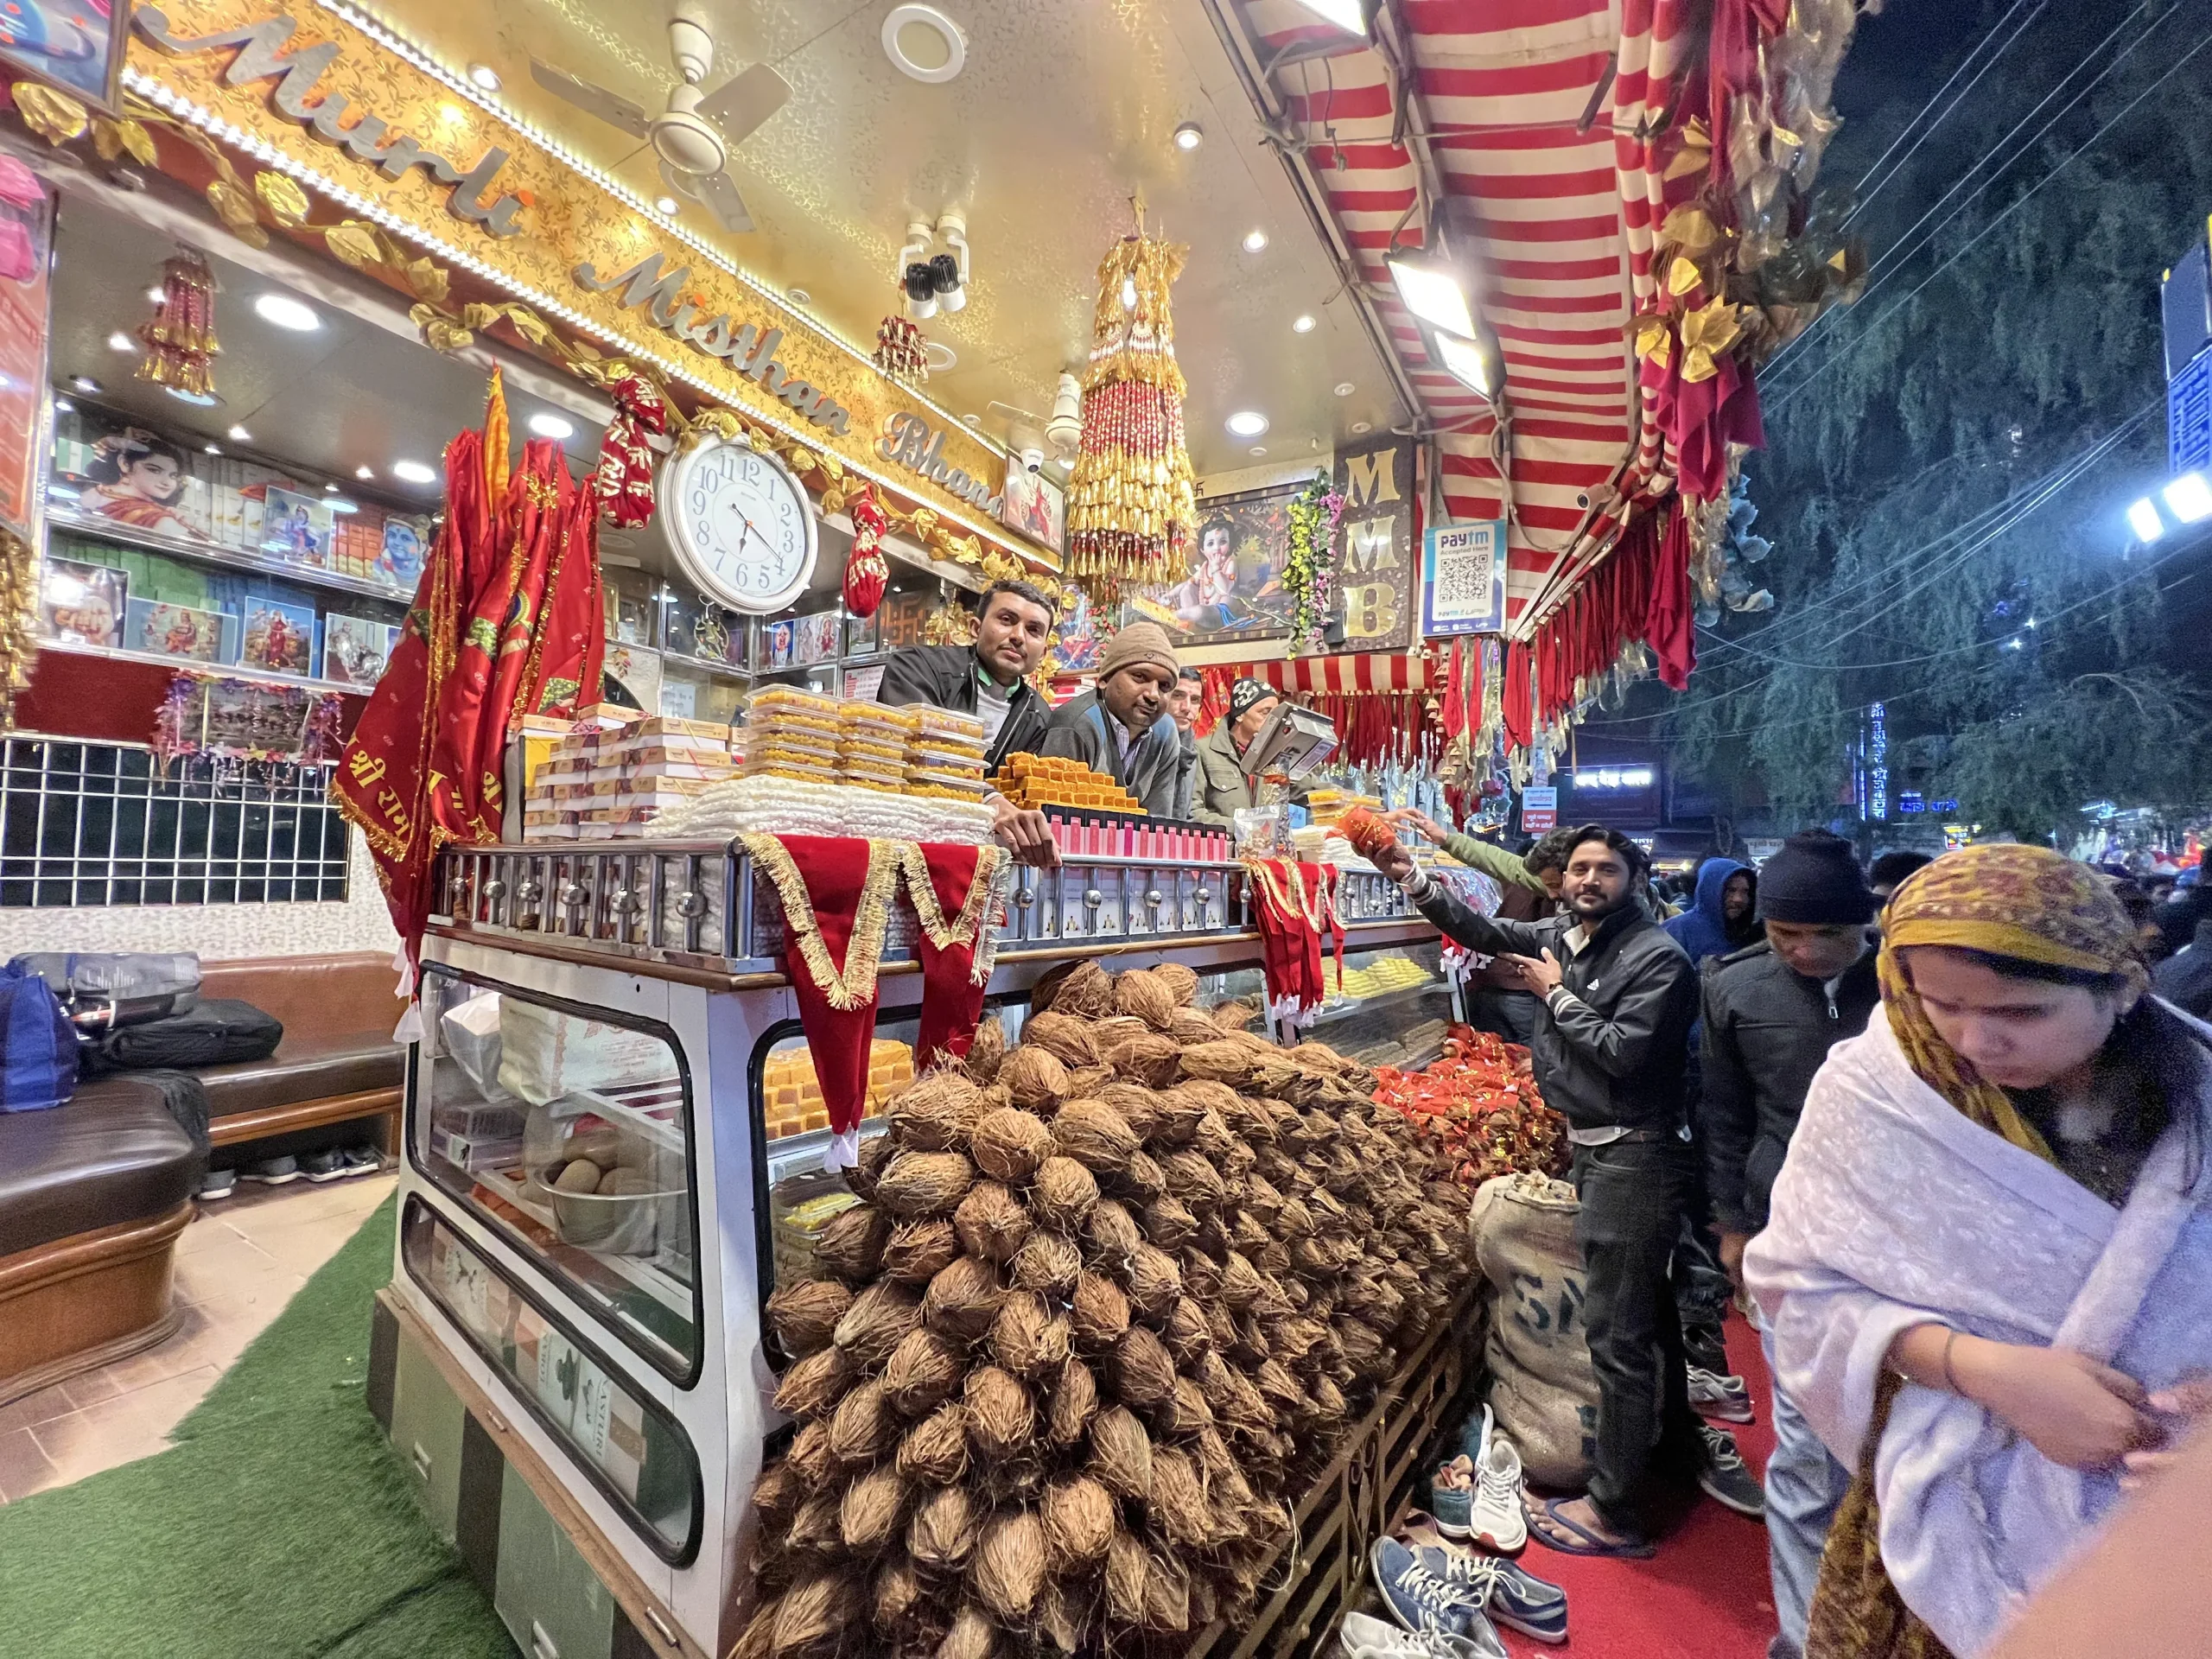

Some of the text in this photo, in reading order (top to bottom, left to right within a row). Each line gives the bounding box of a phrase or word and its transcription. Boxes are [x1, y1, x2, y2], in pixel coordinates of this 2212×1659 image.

[570, 251, 851, 436] Misthan
[699, 466, 718, 493] 10
[741, 459, 760, 486] 12
[692, 490, 706, 516] 9
[780, 503, 791, 527] 2
[696, 520, 710, 546] 8
[783, 530, 794, 553] 3
[714, 547, 727, 572] 7
[1440, 547, 1471, 556] Accepted
[735, 563, 748, 587] 6
[758, 564, 770, 588] 5
[349, 750, 410, 837] श्री राम
